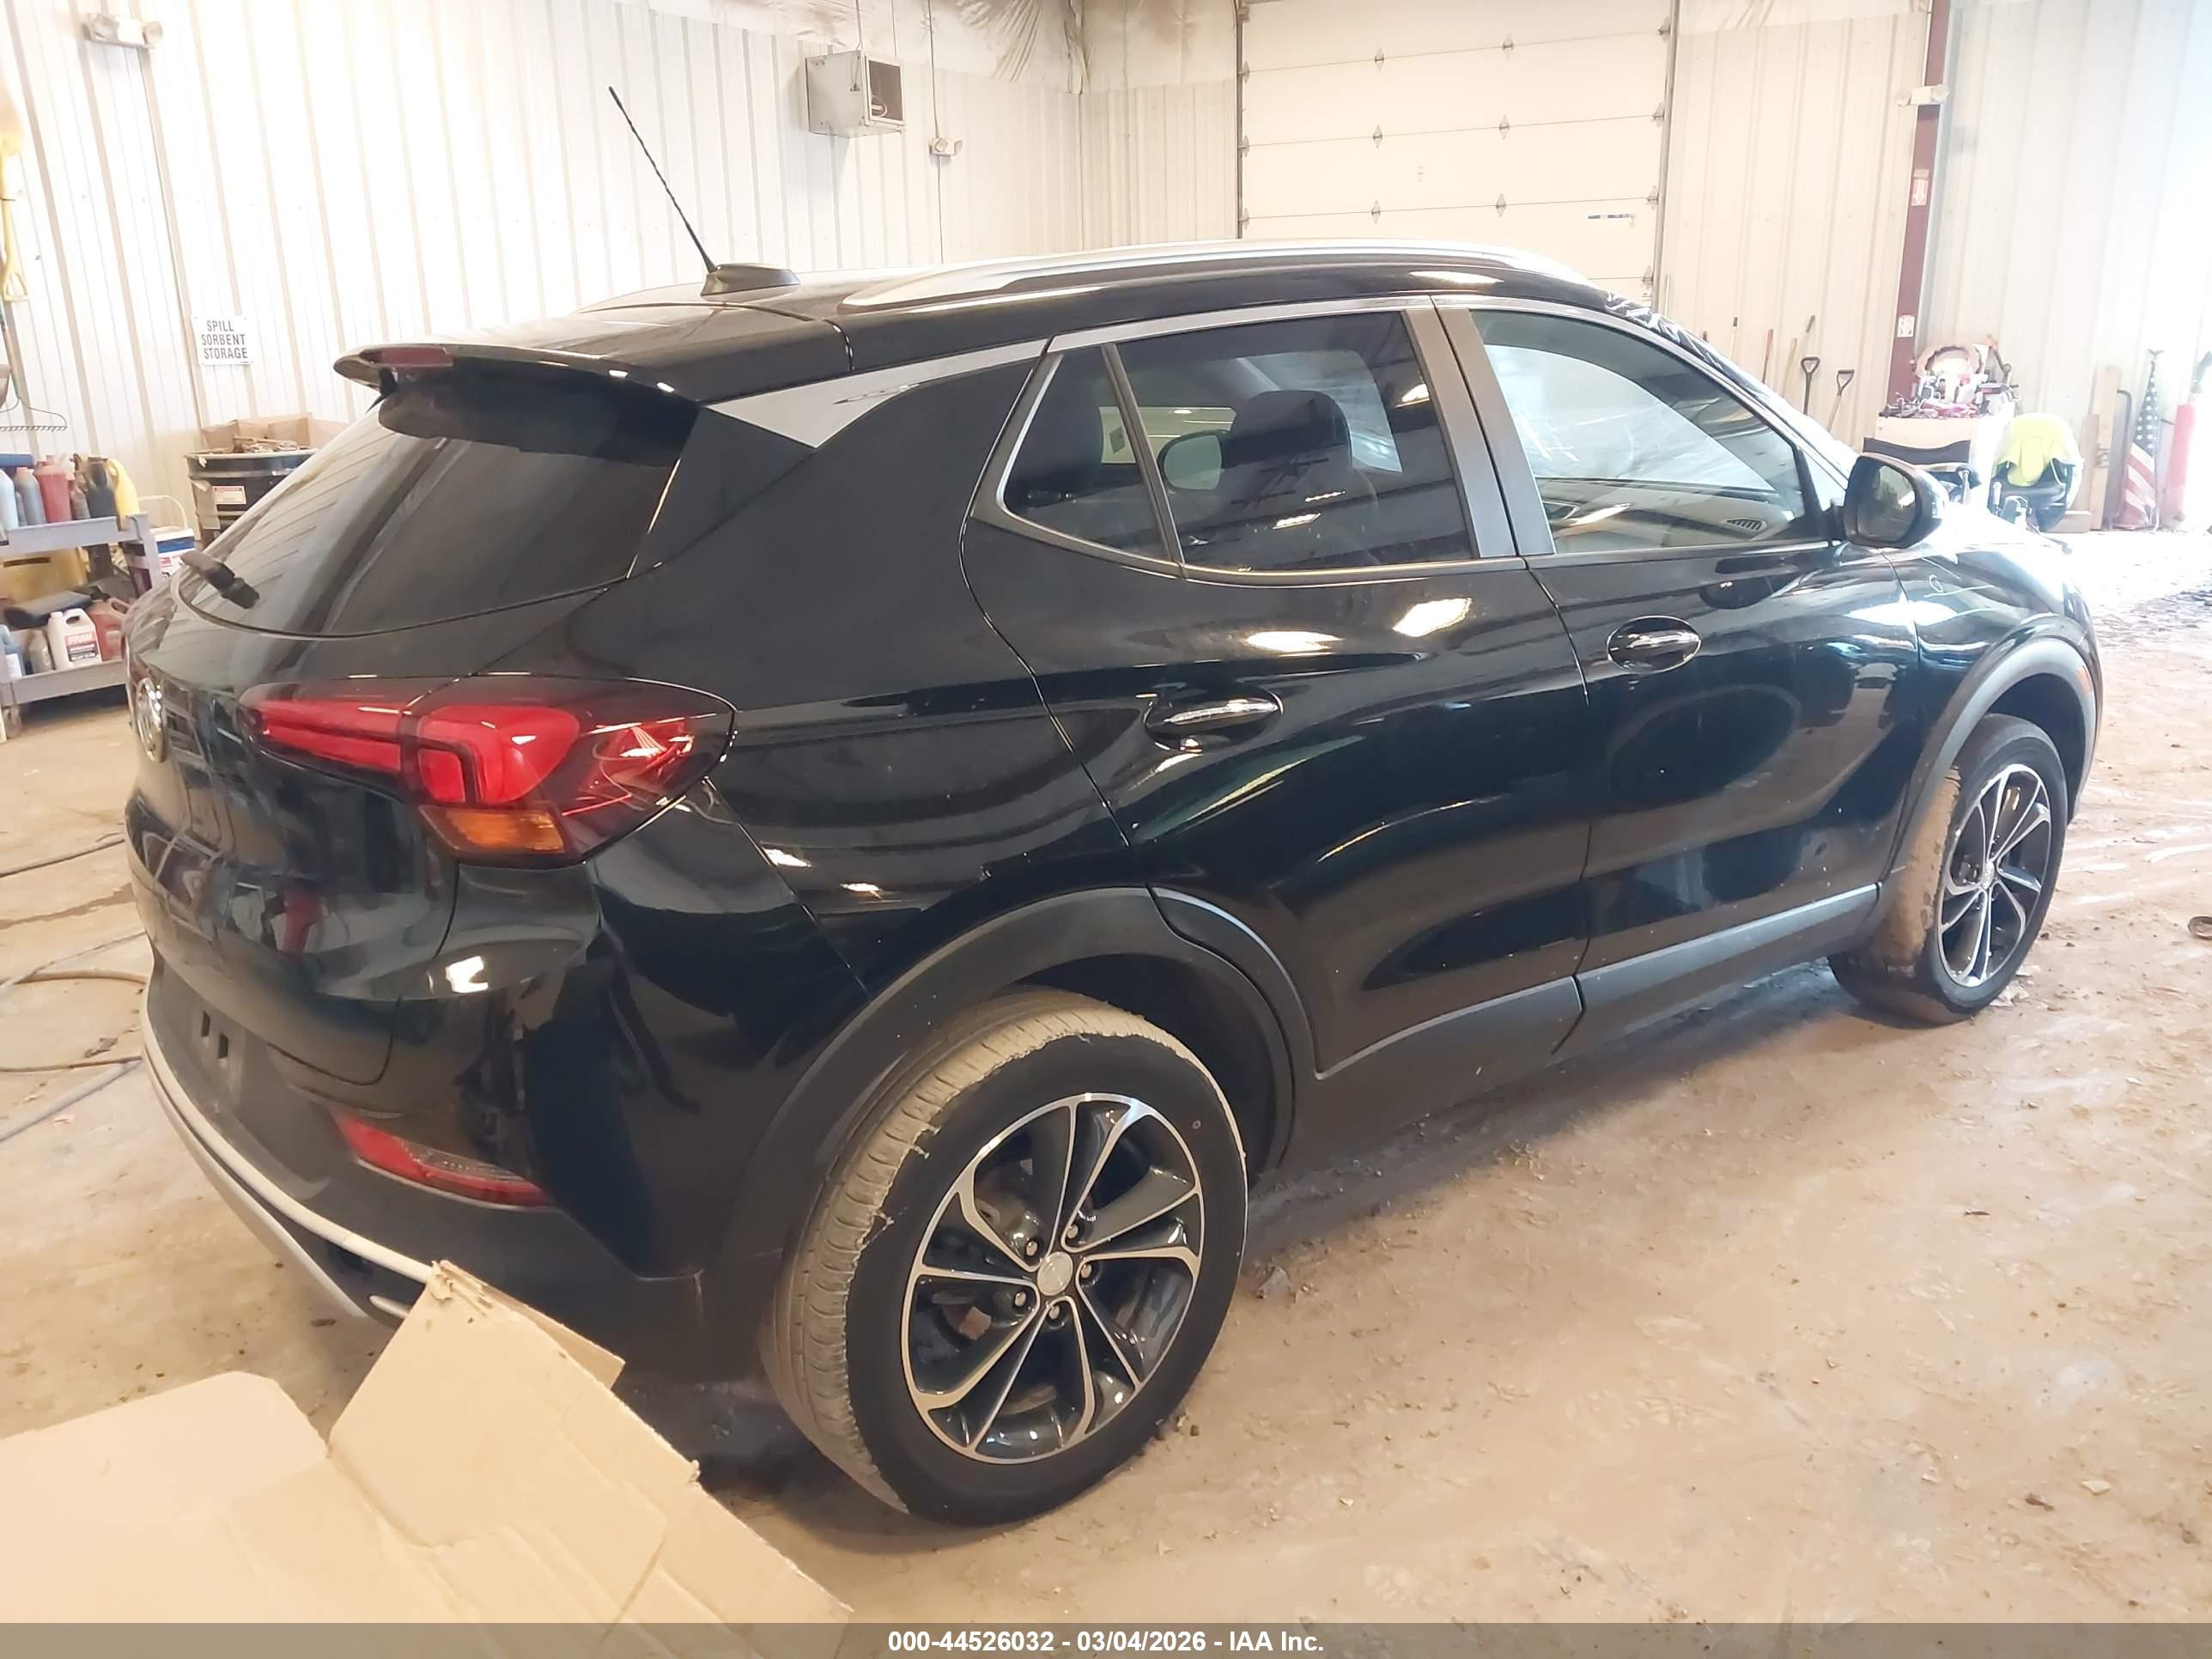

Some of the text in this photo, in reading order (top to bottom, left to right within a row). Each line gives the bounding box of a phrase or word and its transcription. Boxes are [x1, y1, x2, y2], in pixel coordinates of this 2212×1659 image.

[206, 320, 234, 331] SPILL
[201, 334, 246, 345] SORBENT
[204, 348, 248, 359] STORAGE
